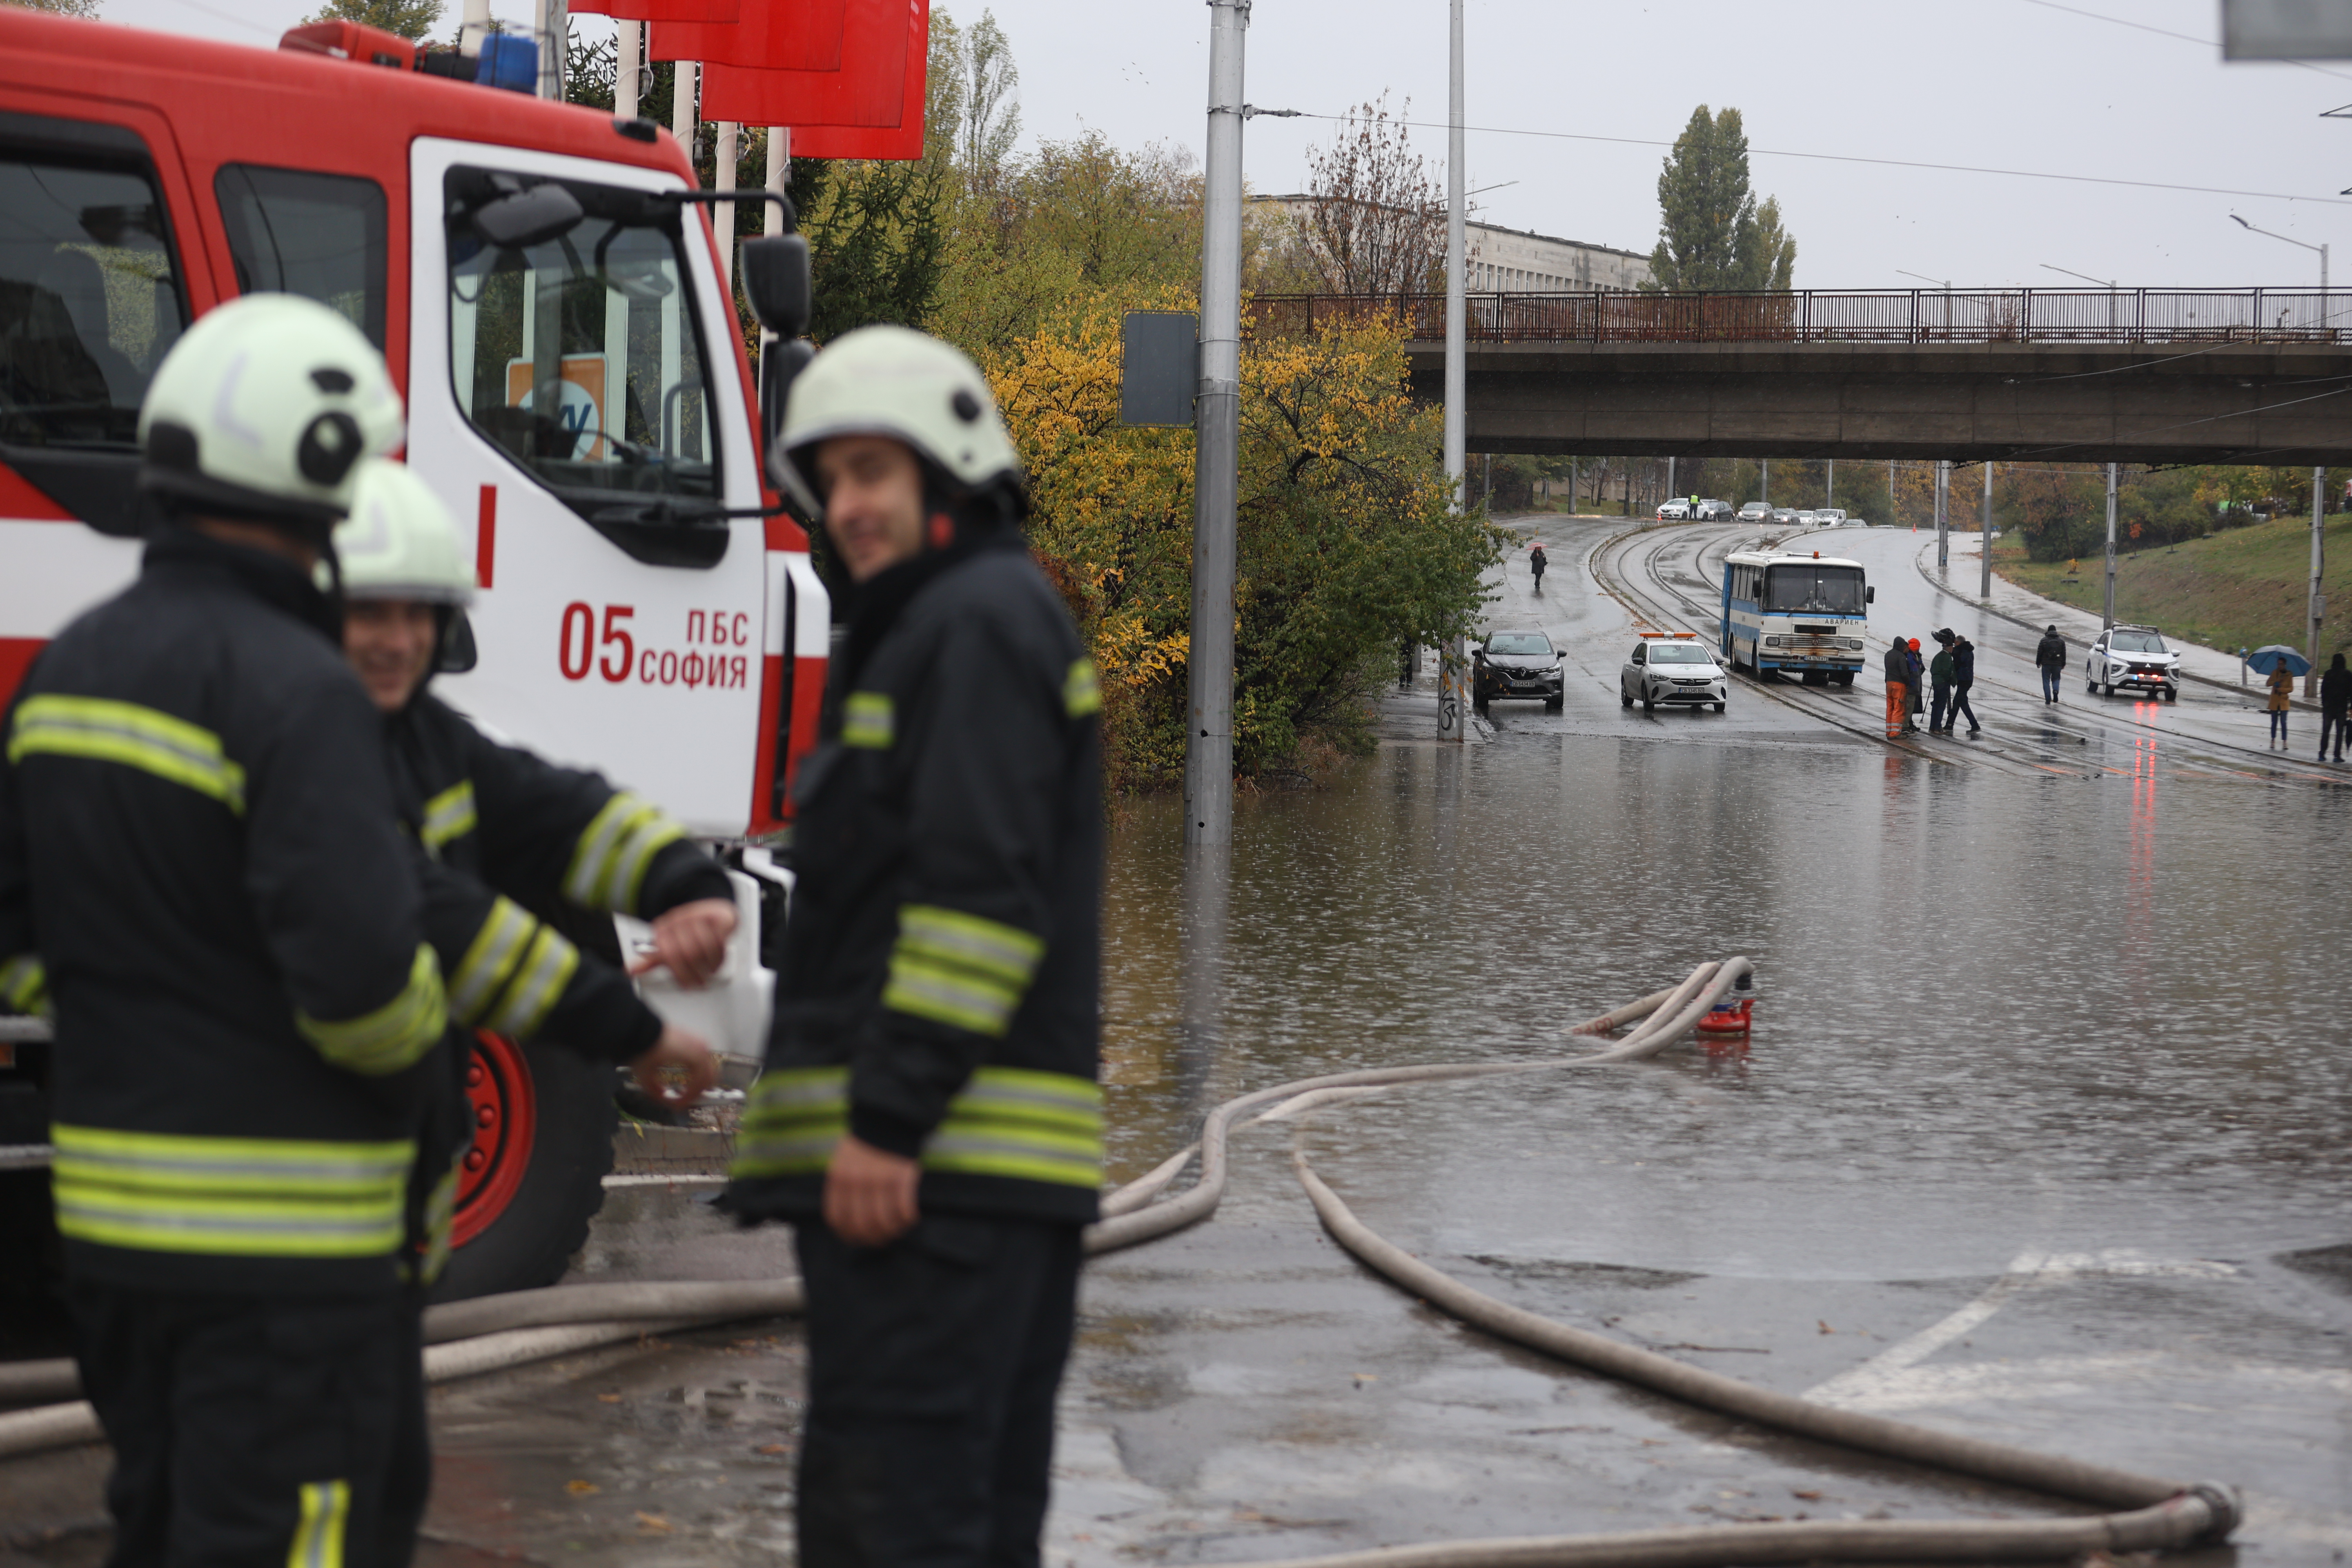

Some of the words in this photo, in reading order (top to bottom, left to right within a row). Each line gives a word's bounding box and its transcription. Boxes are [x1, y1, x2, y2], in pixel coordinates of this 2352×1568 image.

[558, 601, 634, 683] 05
[687, 610, 748, 647] ПБС
[640, 649, 747, 690] СОФИЯ
